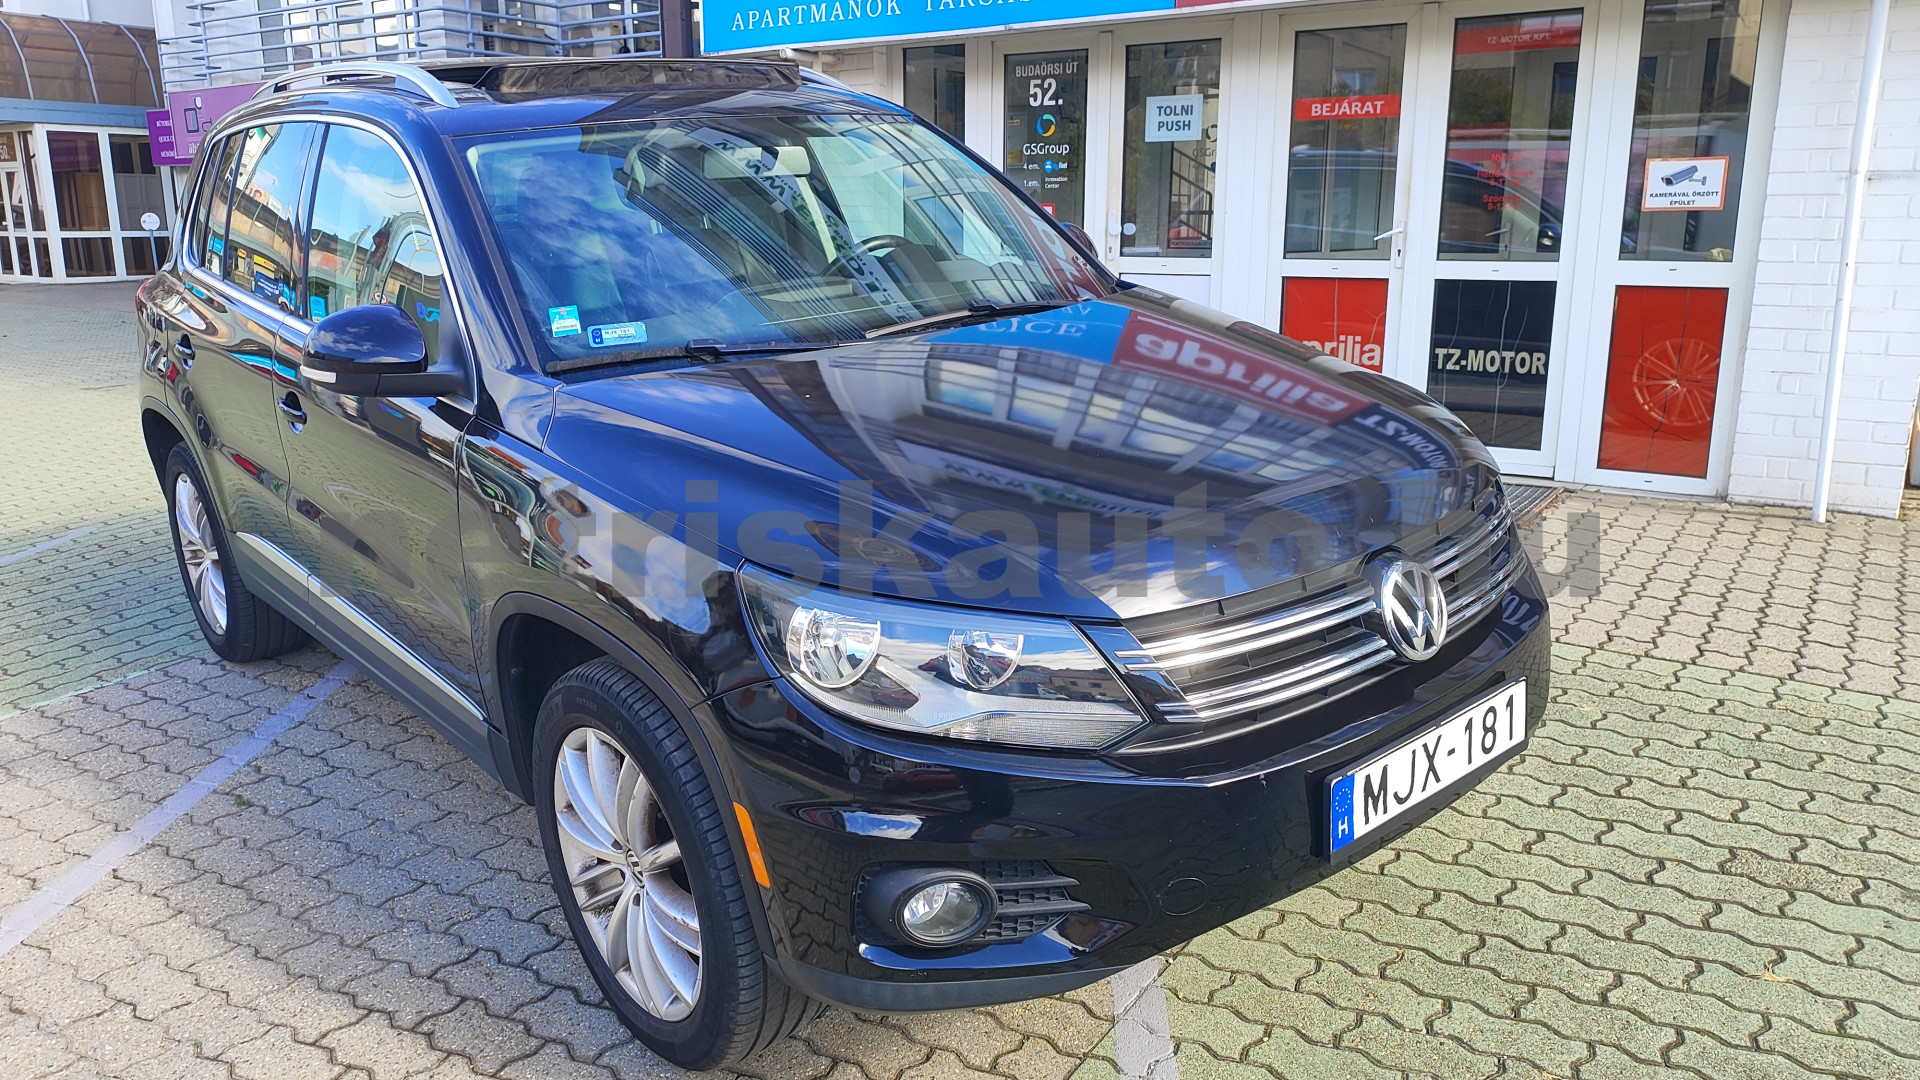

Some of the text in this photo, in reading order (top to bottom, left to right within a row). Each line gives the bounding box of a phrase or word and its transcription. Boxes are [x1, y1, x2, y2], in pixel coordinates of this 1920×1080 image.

[731, 0, 902, 31] APARTMANOK
[1500, 33, 1531, 43] MOTOR
[1015, 58, 1079, 77] BUDAÖRSI ÚT
[1028, 77, 1063, 107] 52.
[1156, 104, 1194, 117] TOLNI
[1311, 99, 1384, 117] BEJÁRAT
[1157, 119, 1192, 132] PUSH
[1023, 143, 1070, 156] GSGroup
[1649, 190, 1690, 198] KAMERÁVAL
[1434, 347, 1546, 376] TZ-MOTOR
[1337, 693, 1515, 840] H MJX-181
